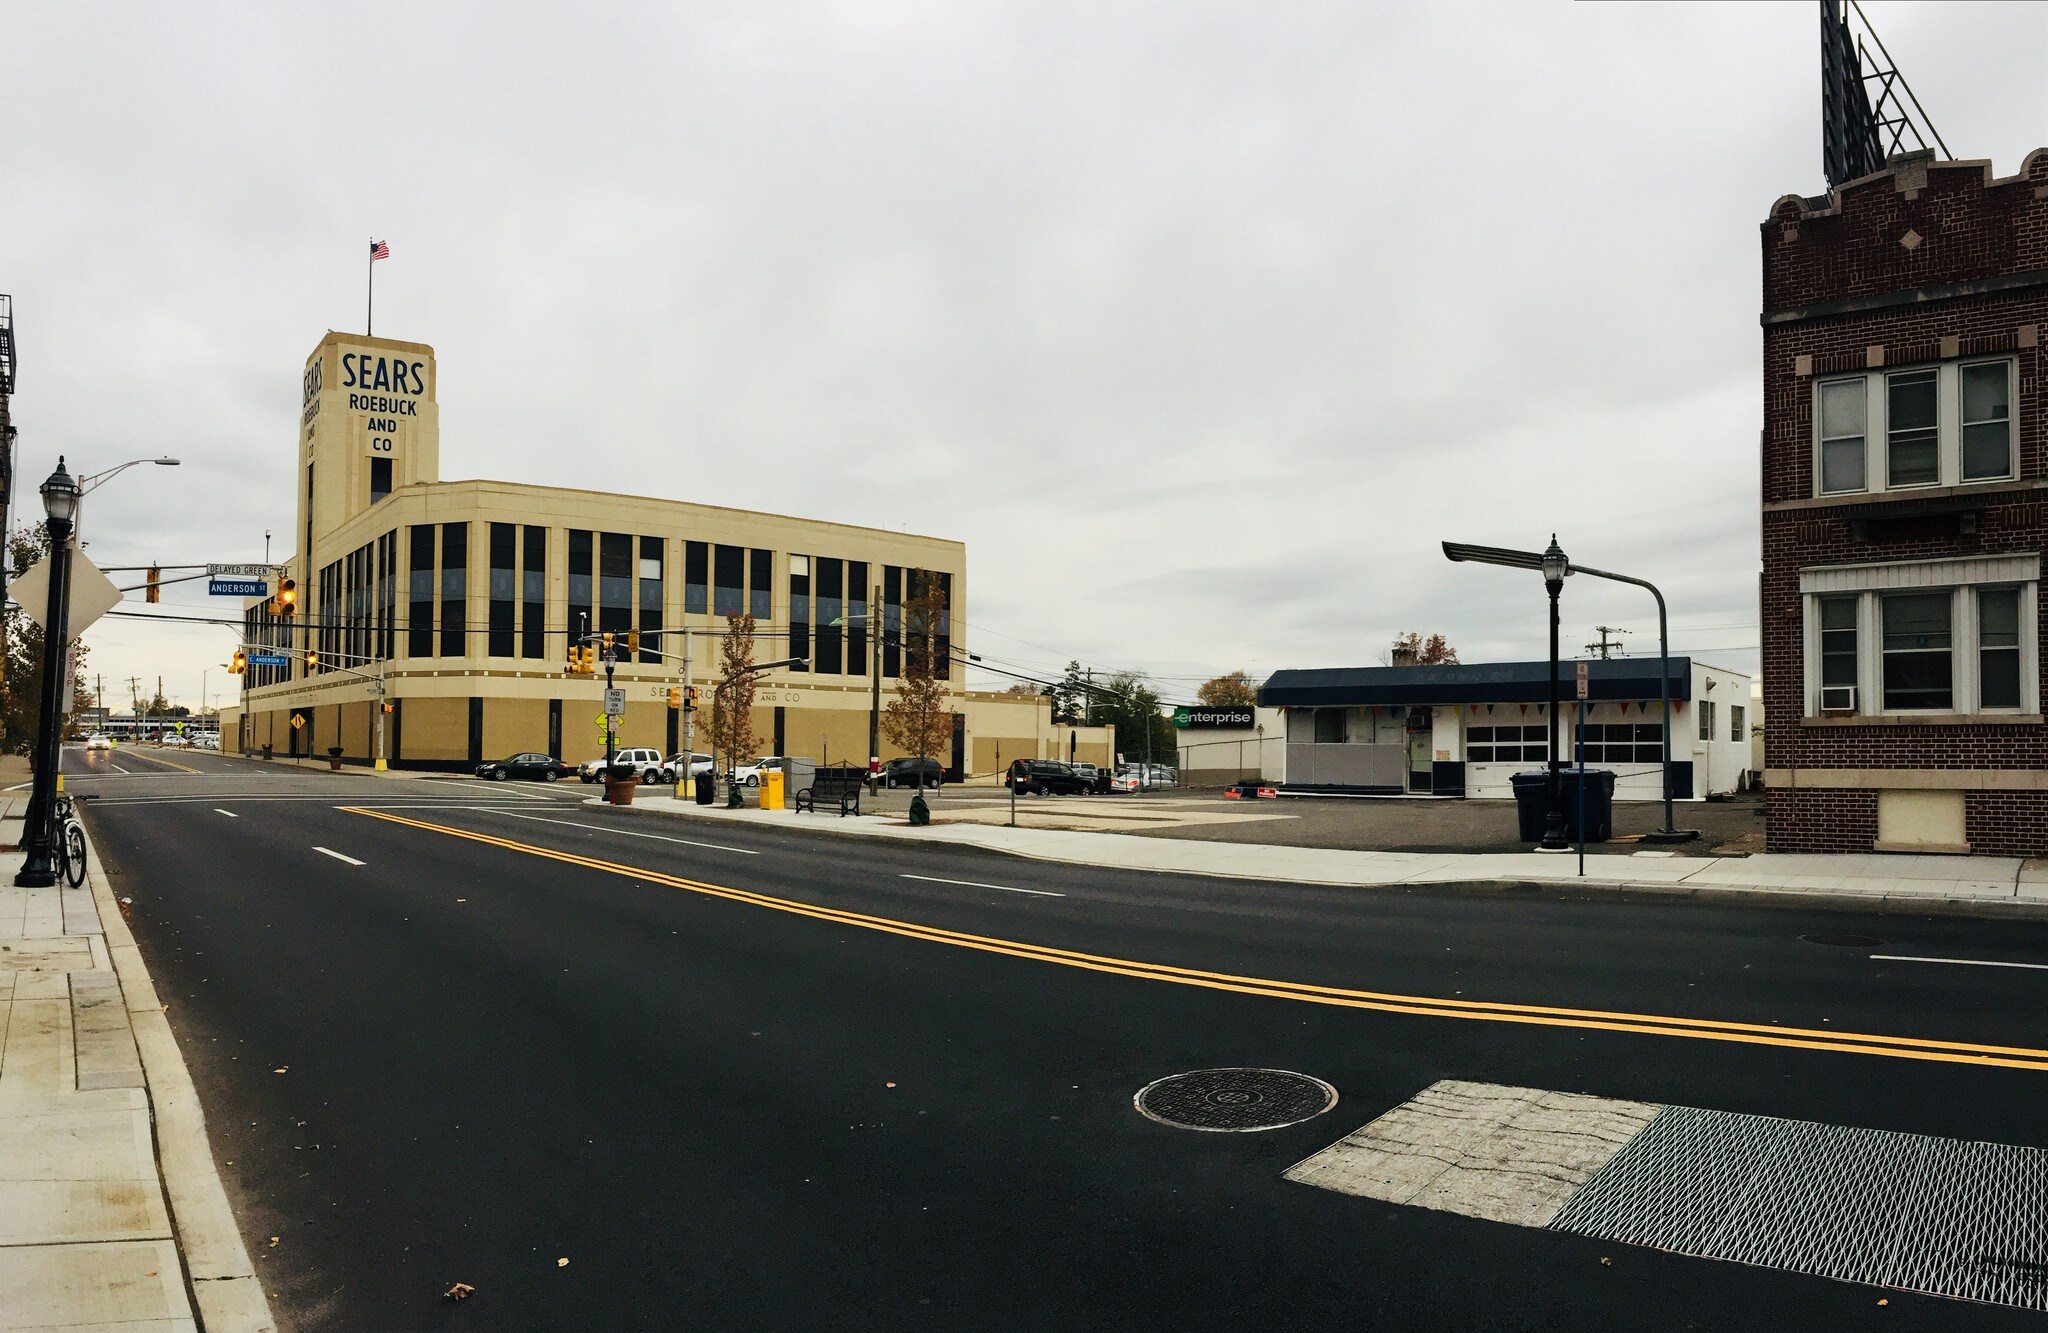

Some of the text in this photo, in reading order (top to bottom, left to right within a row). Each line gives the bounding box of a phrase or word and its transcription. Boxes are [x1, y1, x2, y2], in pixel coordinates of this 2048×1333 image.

[303, 356, 323, 408] SEARS
[342, 353, 424, 396] SEARS
[349, 393, 417, 416] ROEBUCK
[367, 418, 397, 433] AND
[373, 437, 392, 451] CO
[210, 565, 267, 575] DELAYED GREEN
[211, 583, 256, 593] ANDERSON
[66, 653, 75, 687] STOP
[784, 692, 800, 703] CO
[1174, 711, 1251, 726] enterprise
